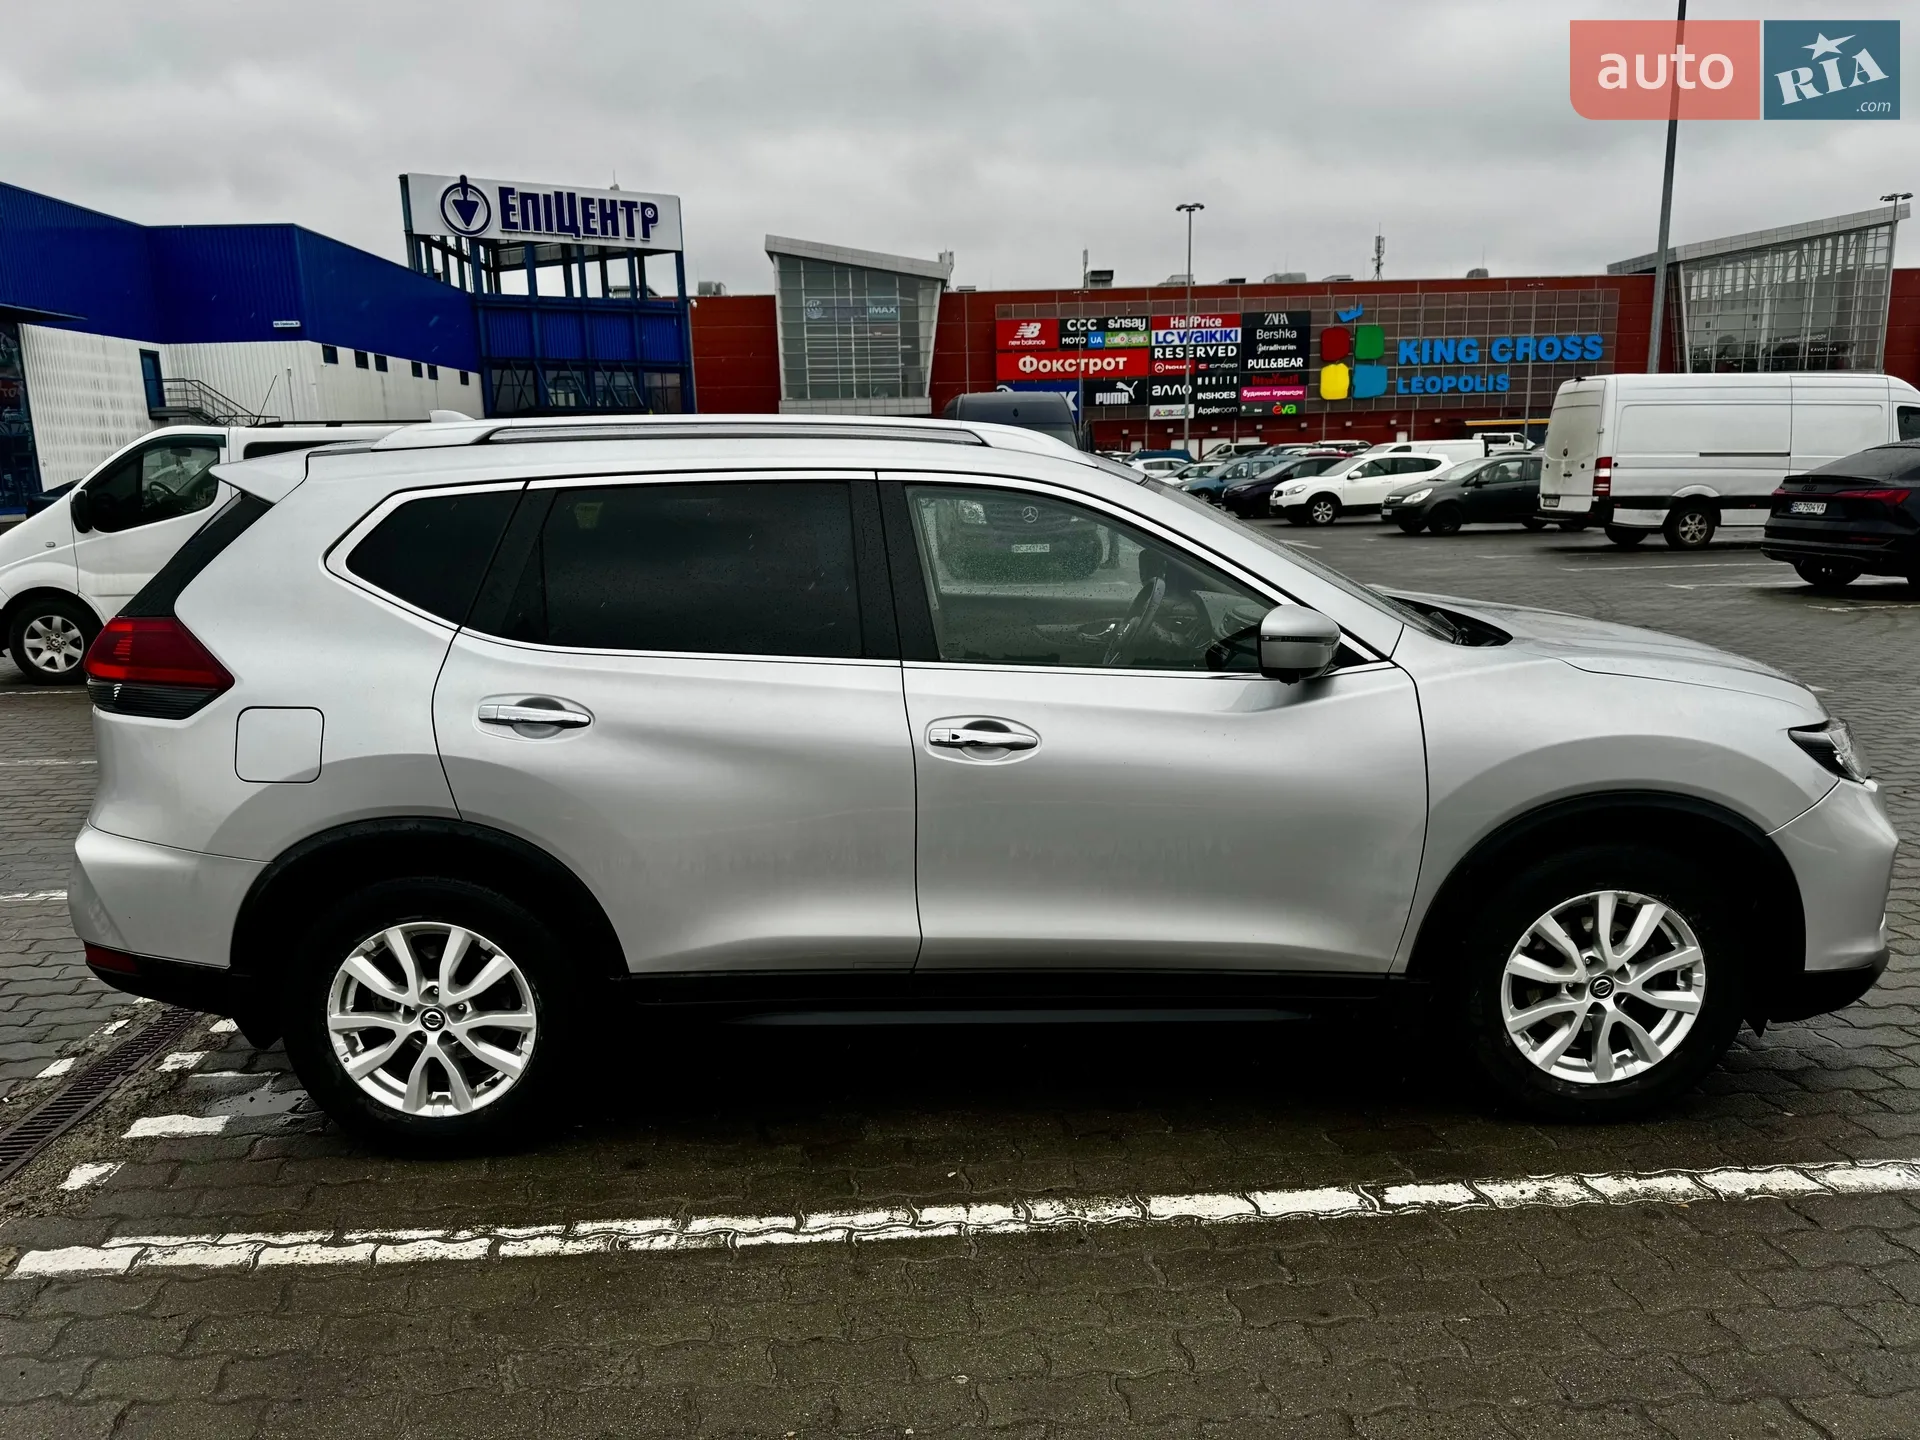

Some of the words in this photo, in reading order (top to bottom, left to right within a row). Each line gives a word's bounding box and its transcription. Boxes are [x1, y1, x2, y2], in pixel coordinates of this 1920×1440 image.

[1067, 319, 1097, 331] CCC
[1107, 316, 1146, 330] sinsay
[1170, 316, 1222, 328] HalfPrice
[1264, 312, 1289, 325] ZARA
[1062, 337, 1086, 345] MOYO
[1090, 336, 1103, 344] UA
[1155, 331, 1175, 344] LC
[1256, 328, 1297, 340] Bershka
[1154, 345, 1237, 358] RESERVED
[1398, 338, 1479, 364] KING
[1490, 334, 1604, 363] CROSS
[1018, 355, 1127, 374] Фокстрот
[1247, 357, 1303, 369] PULL&BEAR
[1397, 373, 1510, 394] LEOPOLIS
[1095, 392, 1130, 405] PUMA
[1197, 391, 1236, 400] INSHOES
[1197, 406, 1238, 415] Appleroom
